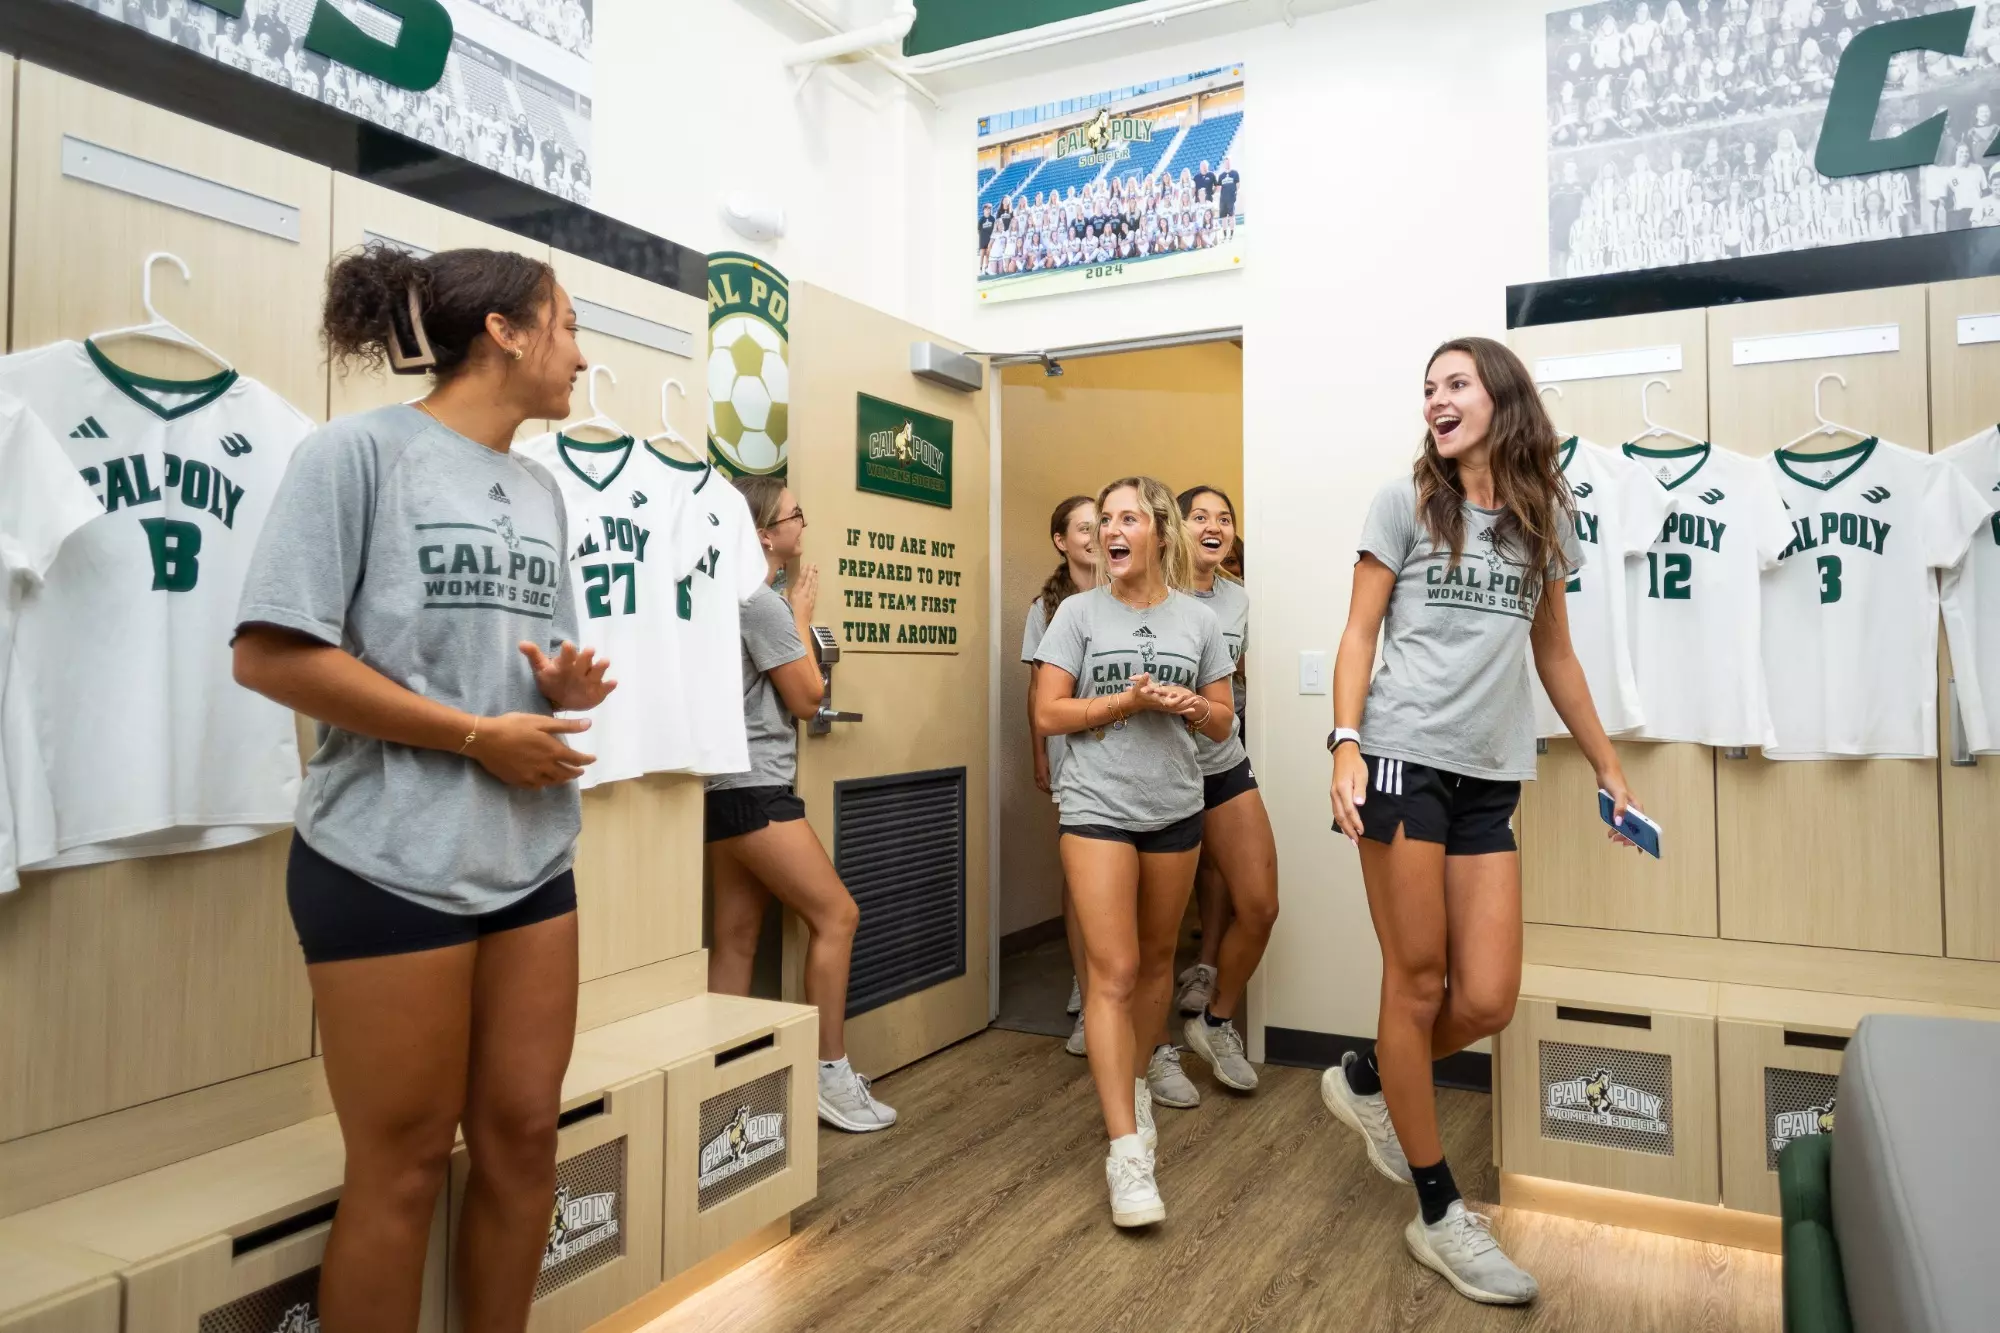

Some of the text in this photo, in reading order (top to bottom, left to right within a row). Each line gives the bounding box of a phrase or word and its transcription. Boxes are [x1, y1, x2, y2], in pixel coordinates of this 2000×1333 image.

[1814, 5, 2000, 178] C
[1056, 119, 1153, 158] CAL POLY
[1079, 149, 1129, 167] SOCCER
[1085, 264, 1123, 279] 2024
[750, 276, 788, 330] PO
[869, 431, 944, 475] CAL POLY
[846, 528, 955, 559] IF YOU ARE NOT
[1661, 511, 1727, 553] POLY
[1819, 511, 1892, 556] POLY
[418, 543, 558, 589] CAL POL
[838, 557, 961, 587] PREPARED TO PUT
[1427, 565, 1482, 589] CAL
[1647, 551, 1692, 599] 12
[1816, 554, 1842, 605] 3
[423, 580, 517, 601] WOMEN'S
[581, 562, 636, 619] 27
[843, 589, 957, 614] THE TEAM FIRST
[1427, 588, 1496, 606] WOMEN'S
[842, 621, 891, 643] TURN
[896, 623, 957, 645] AROUND
[1549, 1081, 1662, 1119] CAL POLY
[1611, 1115, 1668, 1133] SOCCER
[1776, 1112, 1820, 1138] CAL
[701, 1114, 783, 1175] CAL POLY
[746, 1139, 785, 1164] SOCCER
[566, 1193, 615, 1231] POLY
[564, 1221, 618, 1257] SOCCER
